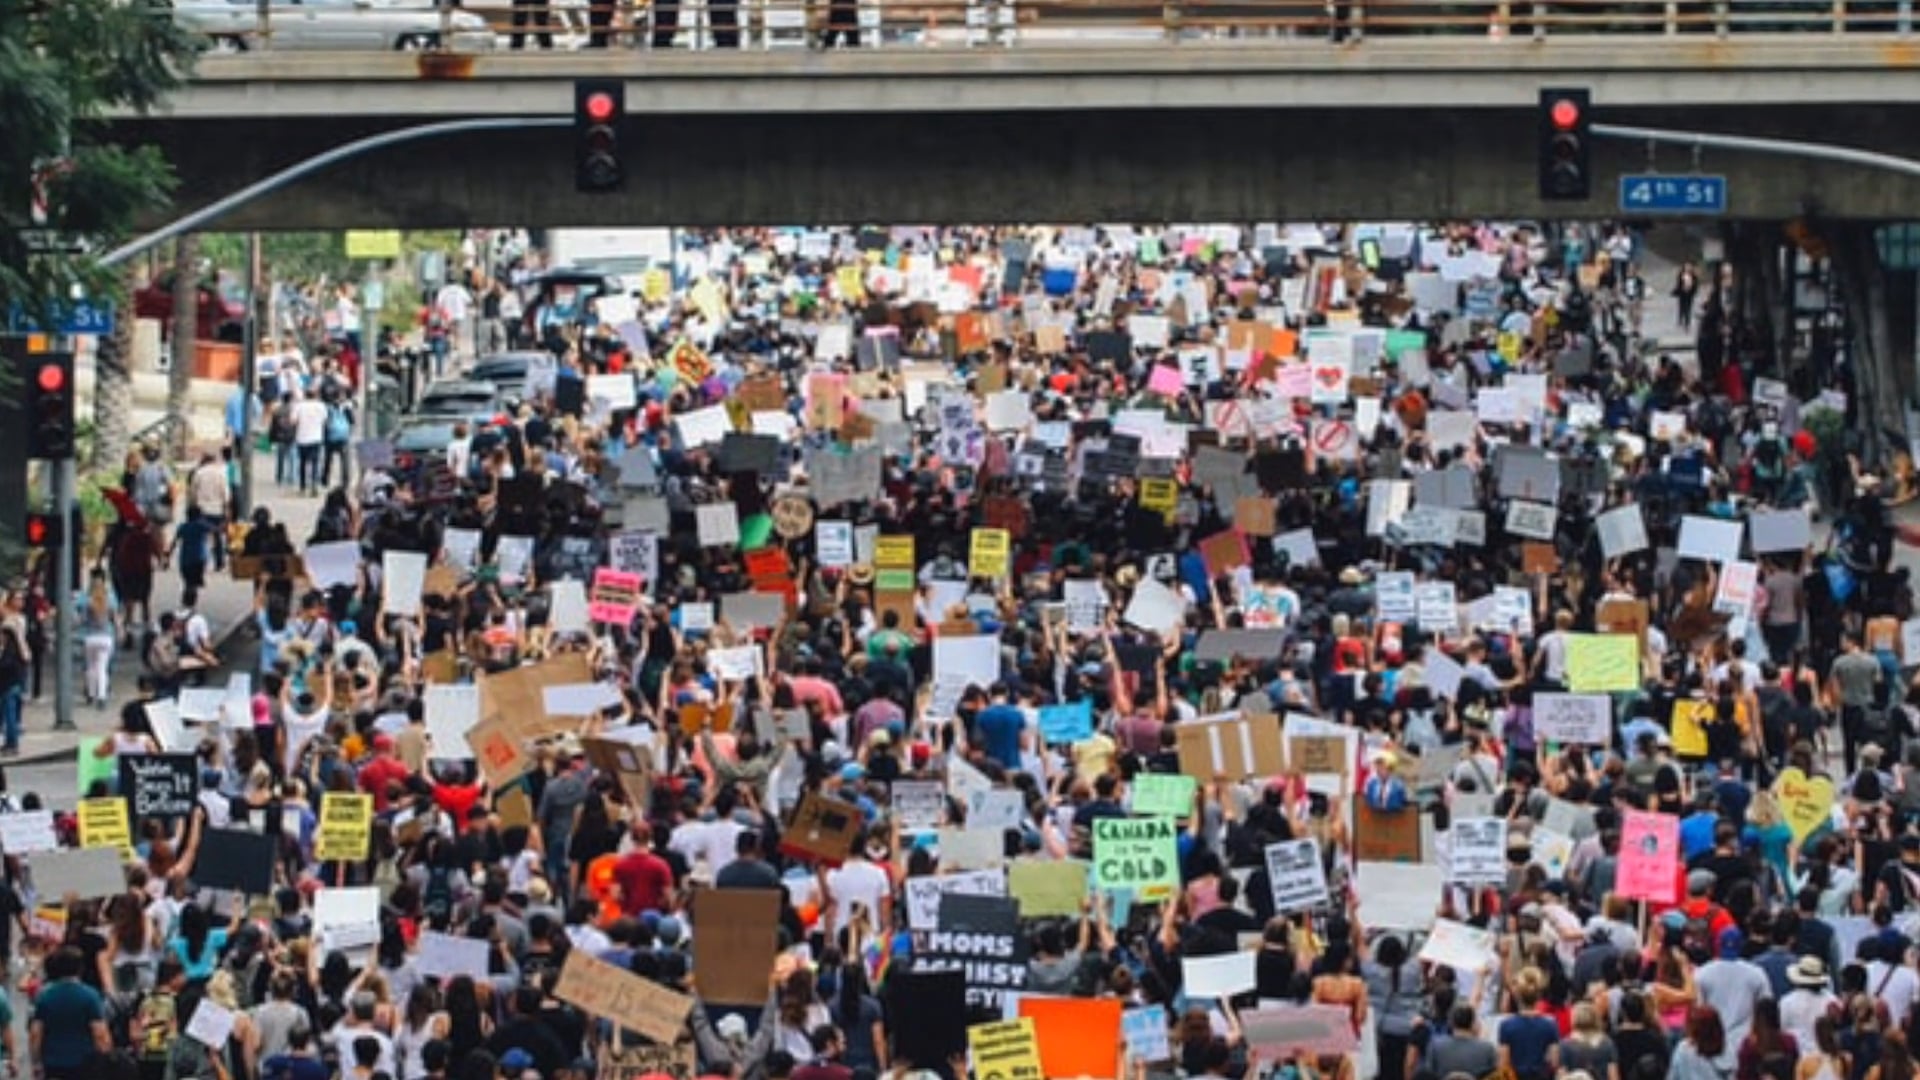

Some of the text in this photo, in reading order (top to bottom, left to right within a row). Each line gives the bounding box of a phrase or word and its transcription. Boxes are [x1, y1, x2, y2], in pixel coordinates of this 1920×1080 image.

[1629, 182, 1714, 203] 4th St
[1098, 821, 1171, 841] CANADA
[1101, 857, 1168, 882] COLD
[929, 932, 1014, 957] MOMS
